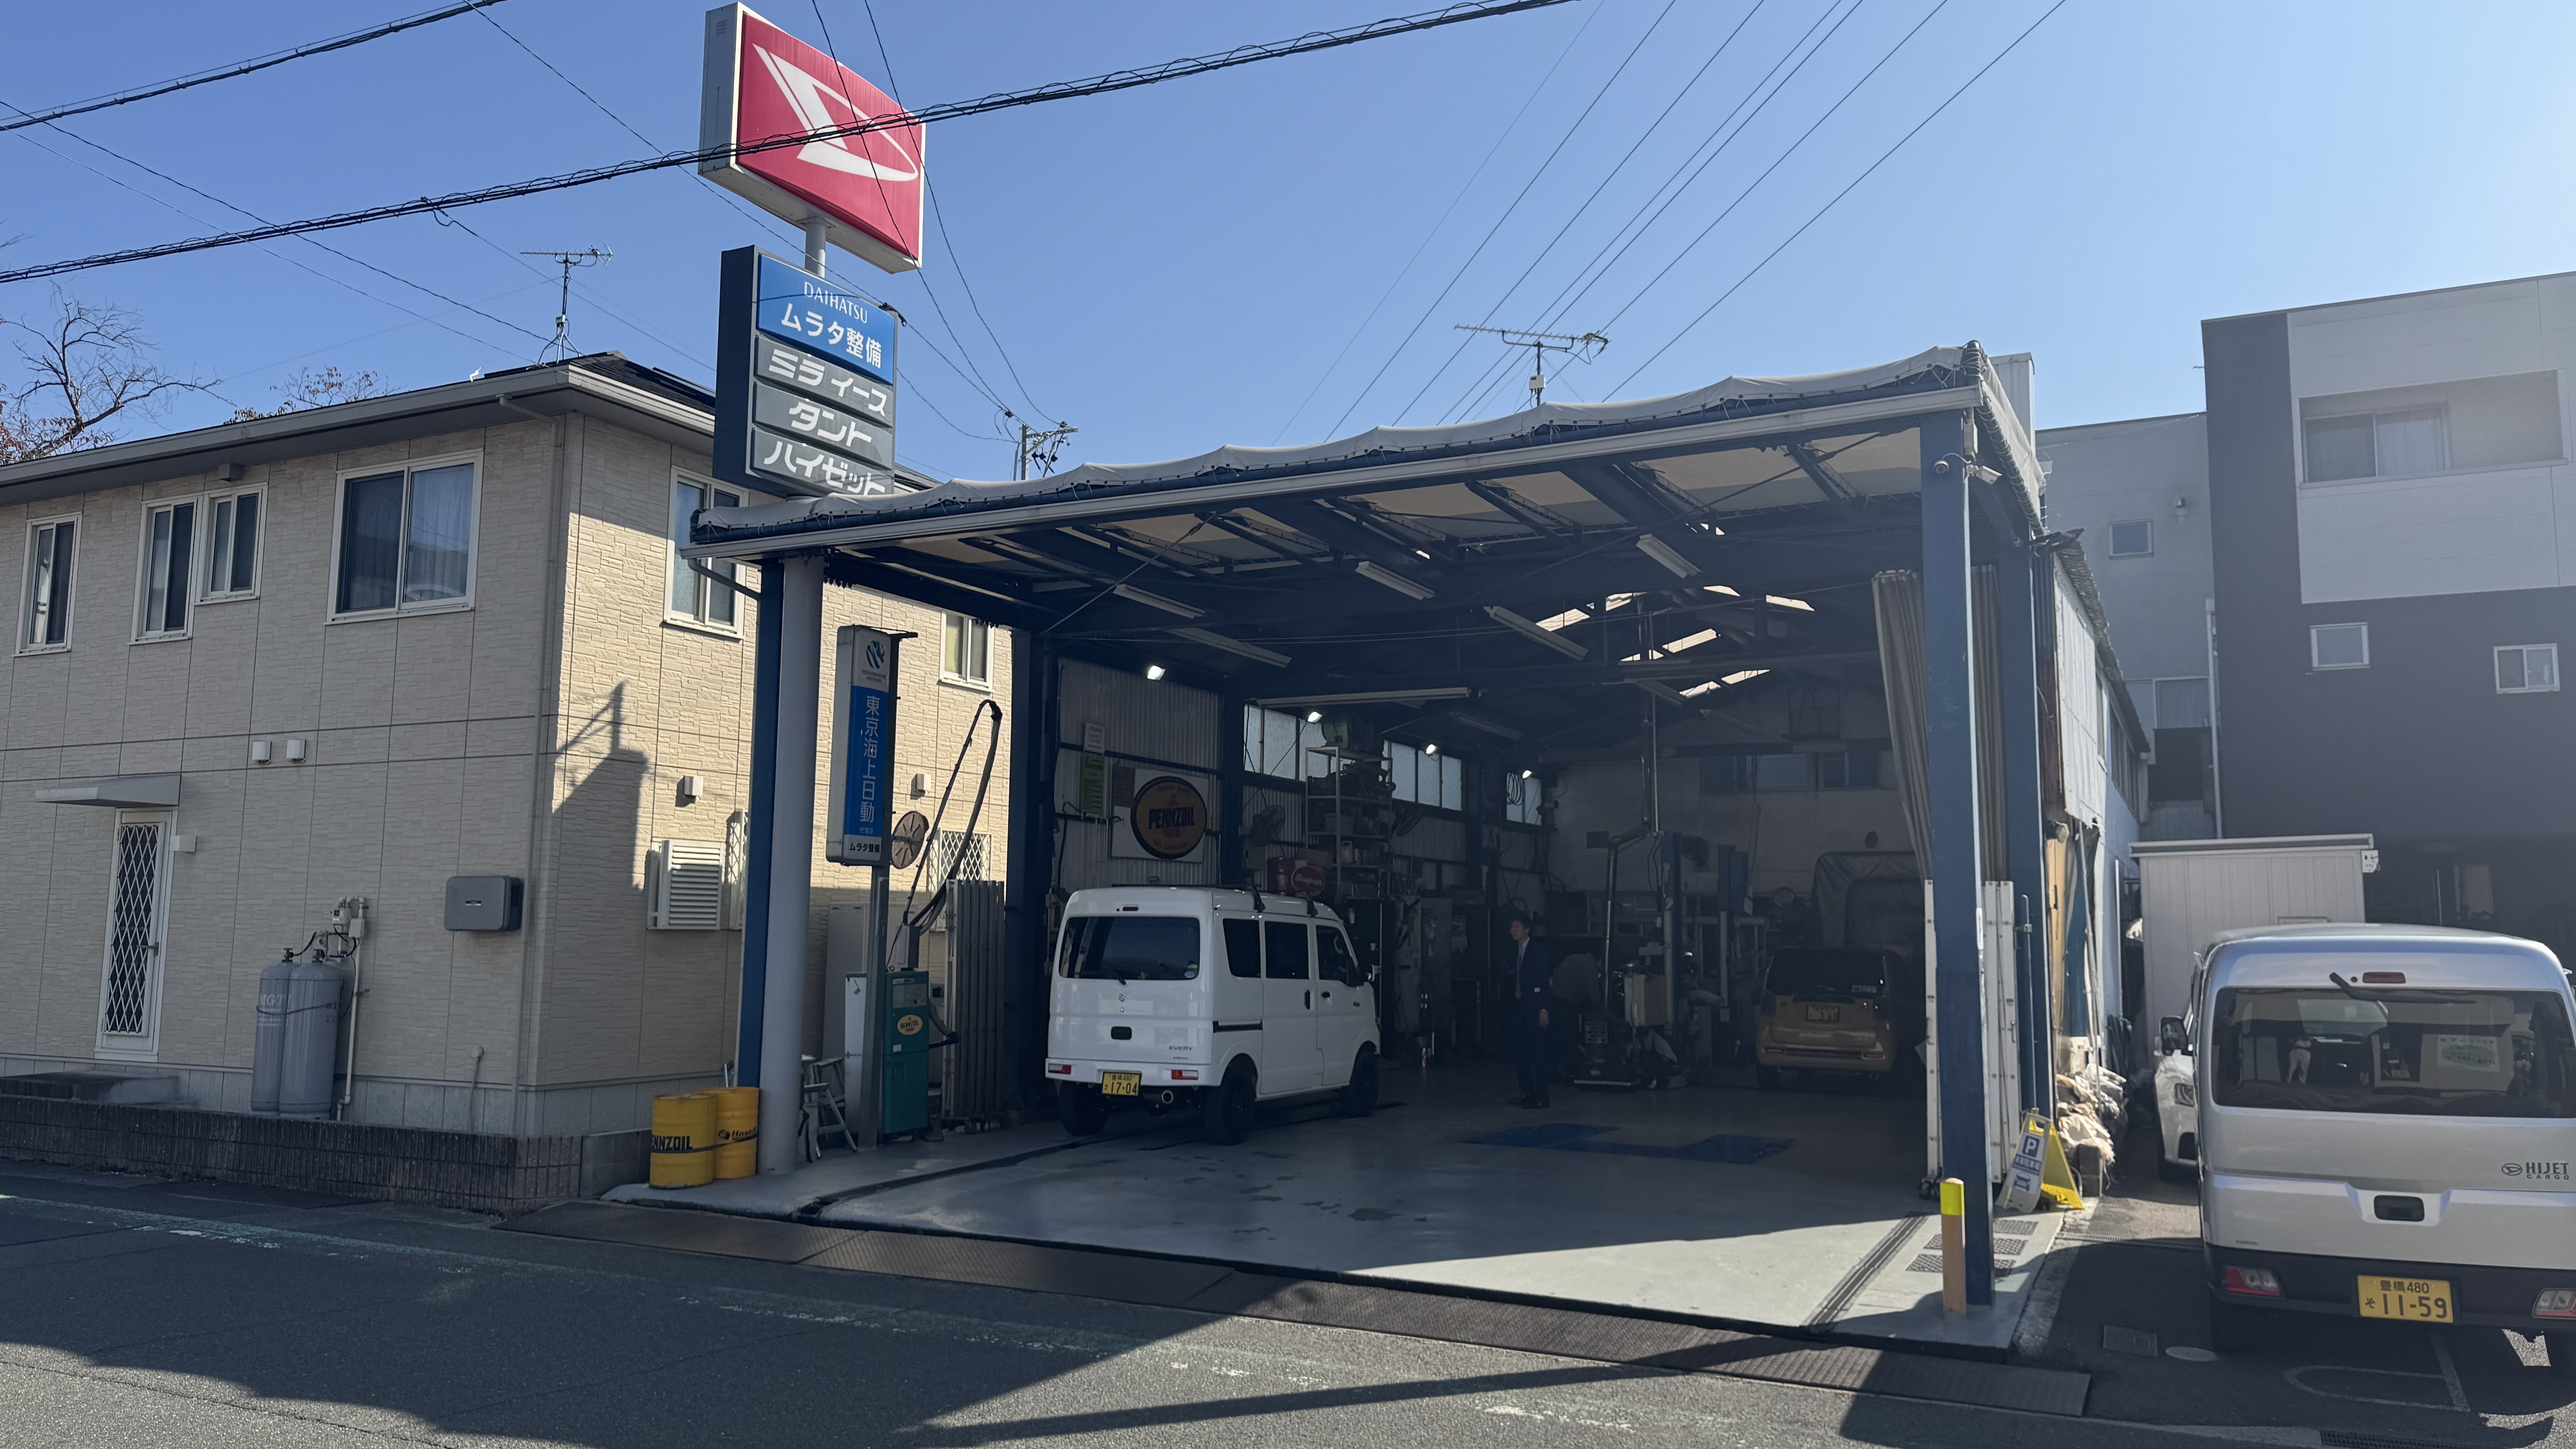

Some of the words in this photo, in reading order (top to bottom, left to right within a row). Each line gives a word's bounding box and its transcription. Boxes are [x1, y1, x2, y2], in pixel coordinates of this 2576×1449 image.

[804, 281, 868, 324] DAIHATSU
[781, 303, 882, 369] ムラタ整備
[768, 349, 825, 386] ミラ
[831, 377, 887, 417] イース
[789, 401, 872, 446] タント
[764, 441, 886, 496] ハイゼット
[860, 695, 880, 823] 東京海上日動
[1148, 806, 1195, 829] PENNZOIL
[850, 842, 880, 853] ムラタ整備
[2025, 1138, 2037, 1154] P
[2526, 1162, 2569, 1174] HIJET
[2383, 1293, 2447, 1319] 11-59
